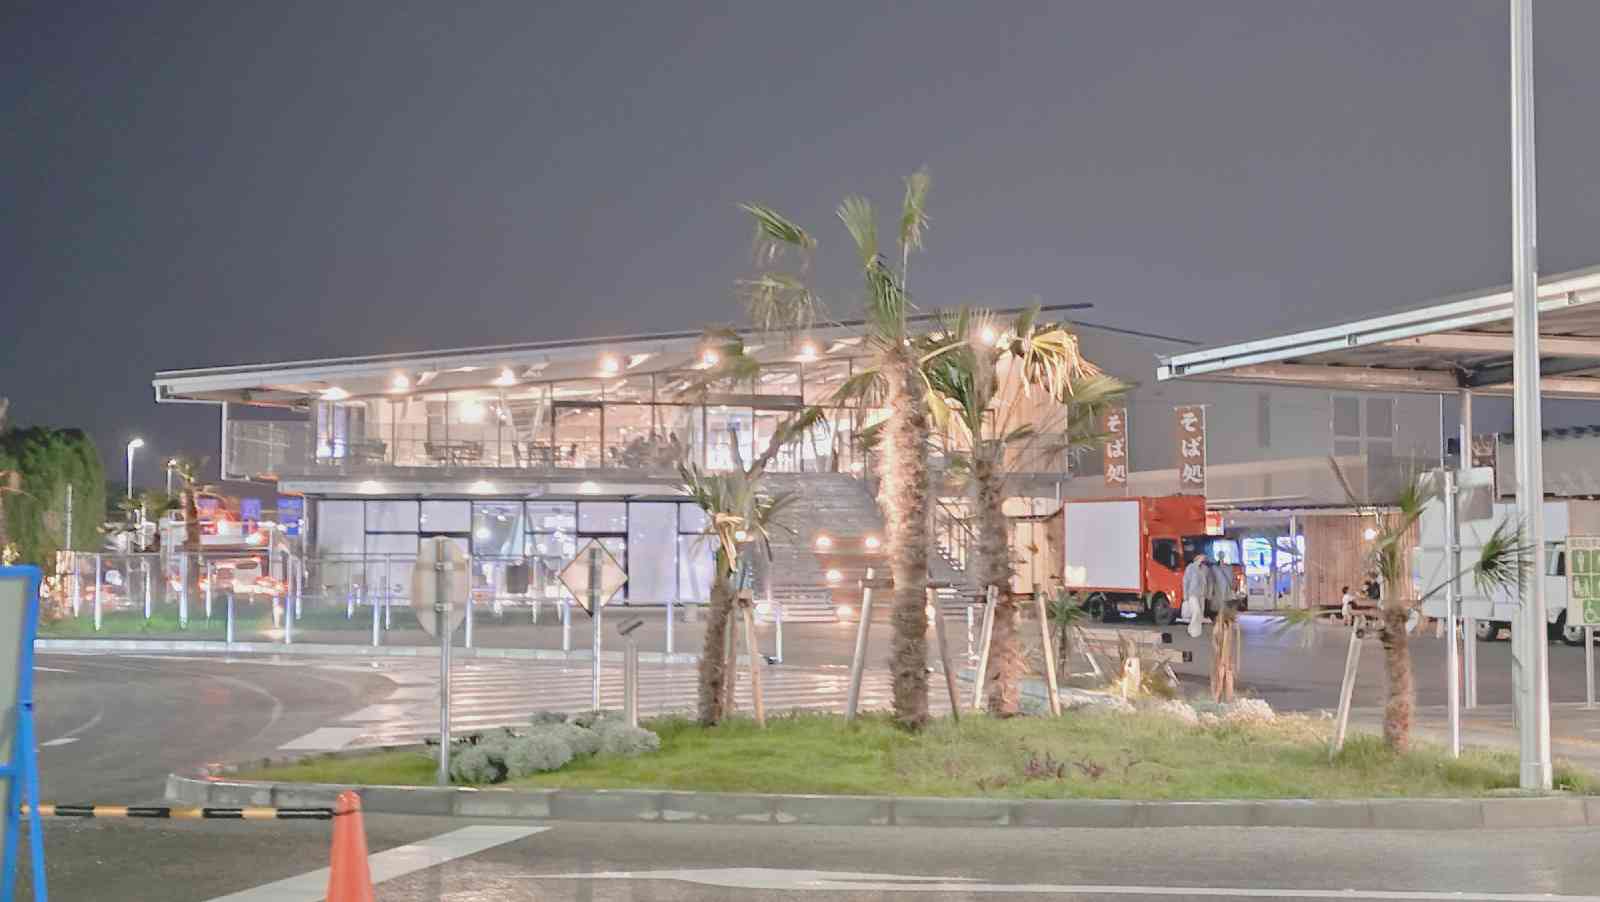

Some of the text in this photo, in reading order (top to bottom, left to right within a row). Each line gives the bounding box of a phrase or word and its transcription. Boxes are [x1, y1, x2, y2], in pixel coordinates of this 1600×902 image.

[1106, 414, 1126, 482] そば処
[1181, 411, 1203, 483] そば処
